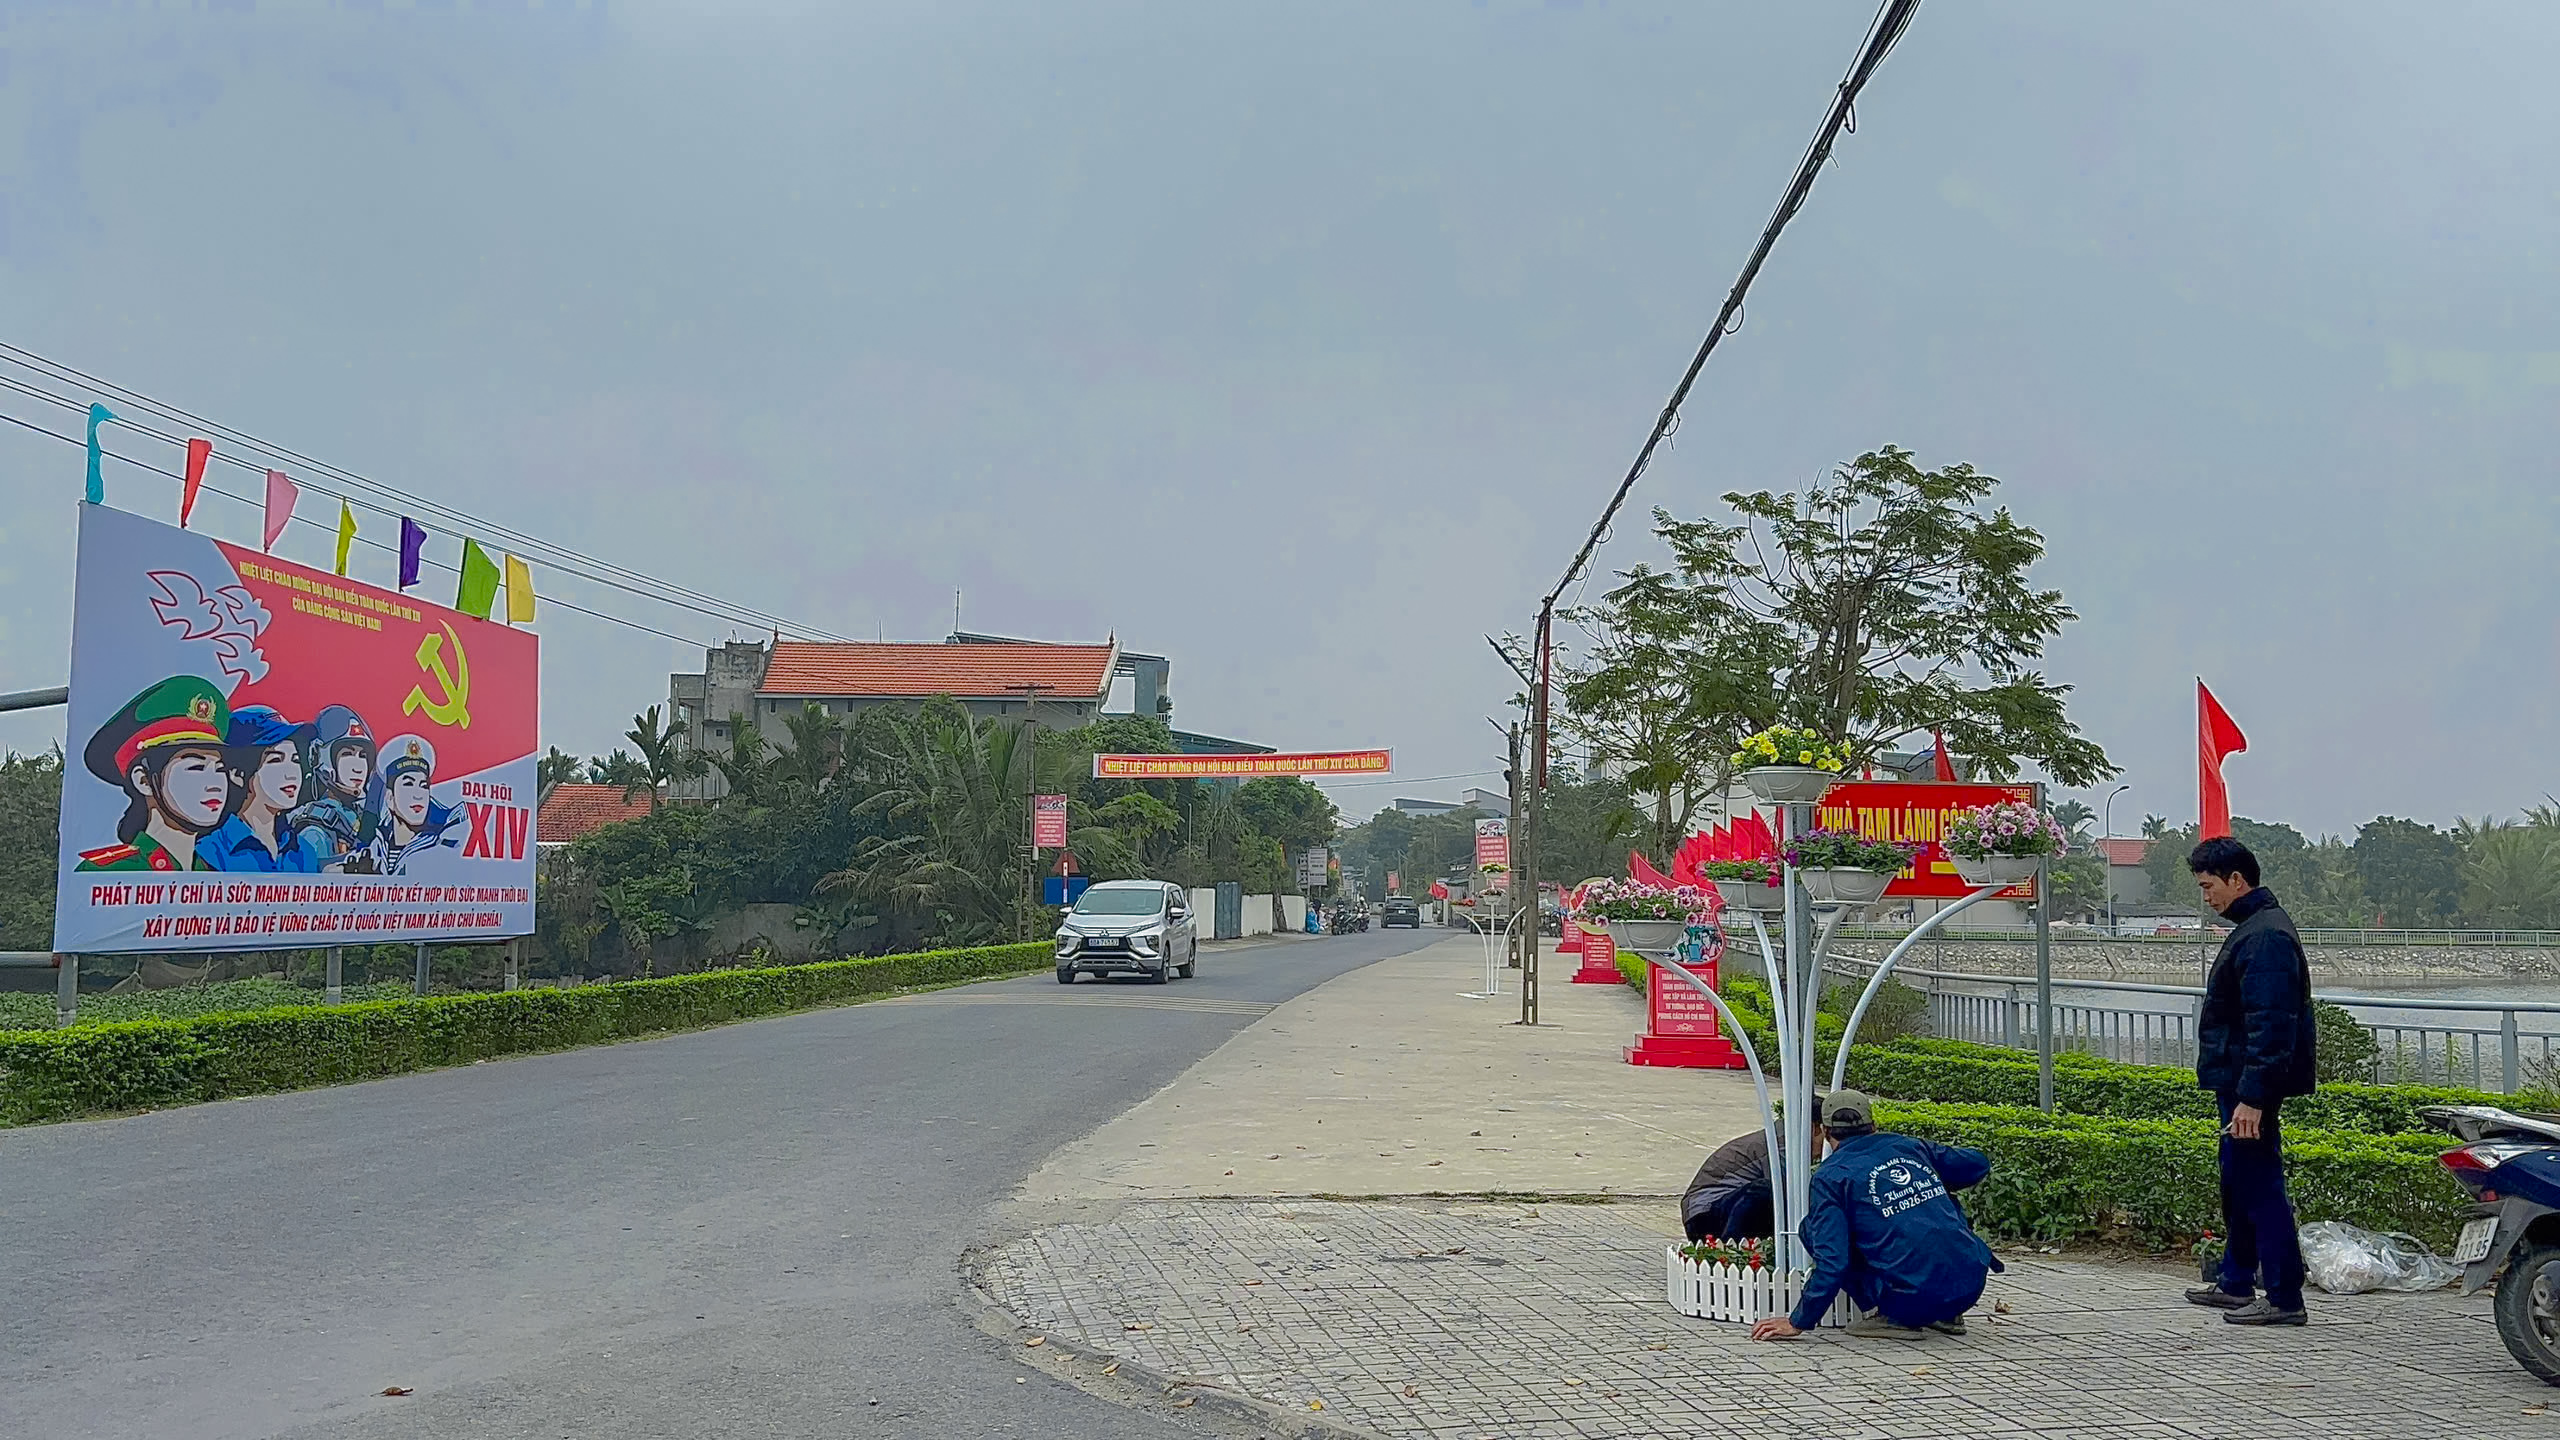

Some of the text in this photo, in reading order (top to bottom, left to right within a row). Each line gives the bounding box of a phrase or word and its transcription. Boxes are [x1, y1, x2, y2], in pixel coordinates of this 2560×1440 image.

[1330, 759, 1343, 770] XIV
[463, 781, 512, 803] ĐẠI HỘI
[462, 801, 530, 860] XIV
[1821, 800, 1854, 832] NHÀ
[1858, 807, 1890, 841] TAM
[1895, 801, 1936, 842] LÁNH
[92, 881, 529, 906] PHÁT HUY Ý CHÍ VÀ SỨC MẠNH ĐẠI ĐOÀN KẾT DÂN TỘC KẾT HỢP VỚI SỨC MẠNH THỜI ĐẠI
[143, 914, 173, 938] XÂY
[175, 915, 211, 940] DỰNG
[216, 912, 231, 935] VÀ
[234, 910, 259, 934] BẢO
[262, 912, 278, 937] VỆ
[279, 911, 309, 933] VỮNG
[311, 908, 339, 931] CHẮC
[342, 908, 356, 930] TỔ
[356, 908, 381, 932] QUỐC
[383, 910, 404, 933] VIỆT
[404, 913, 426, 929] NAM
[427, 910, 440, 928] XÃ
[442, 909, 456, 931] HỘI
[458, 908, 475, 928] CHỦ
[1884, 1186, 1915, 1204] Khang
